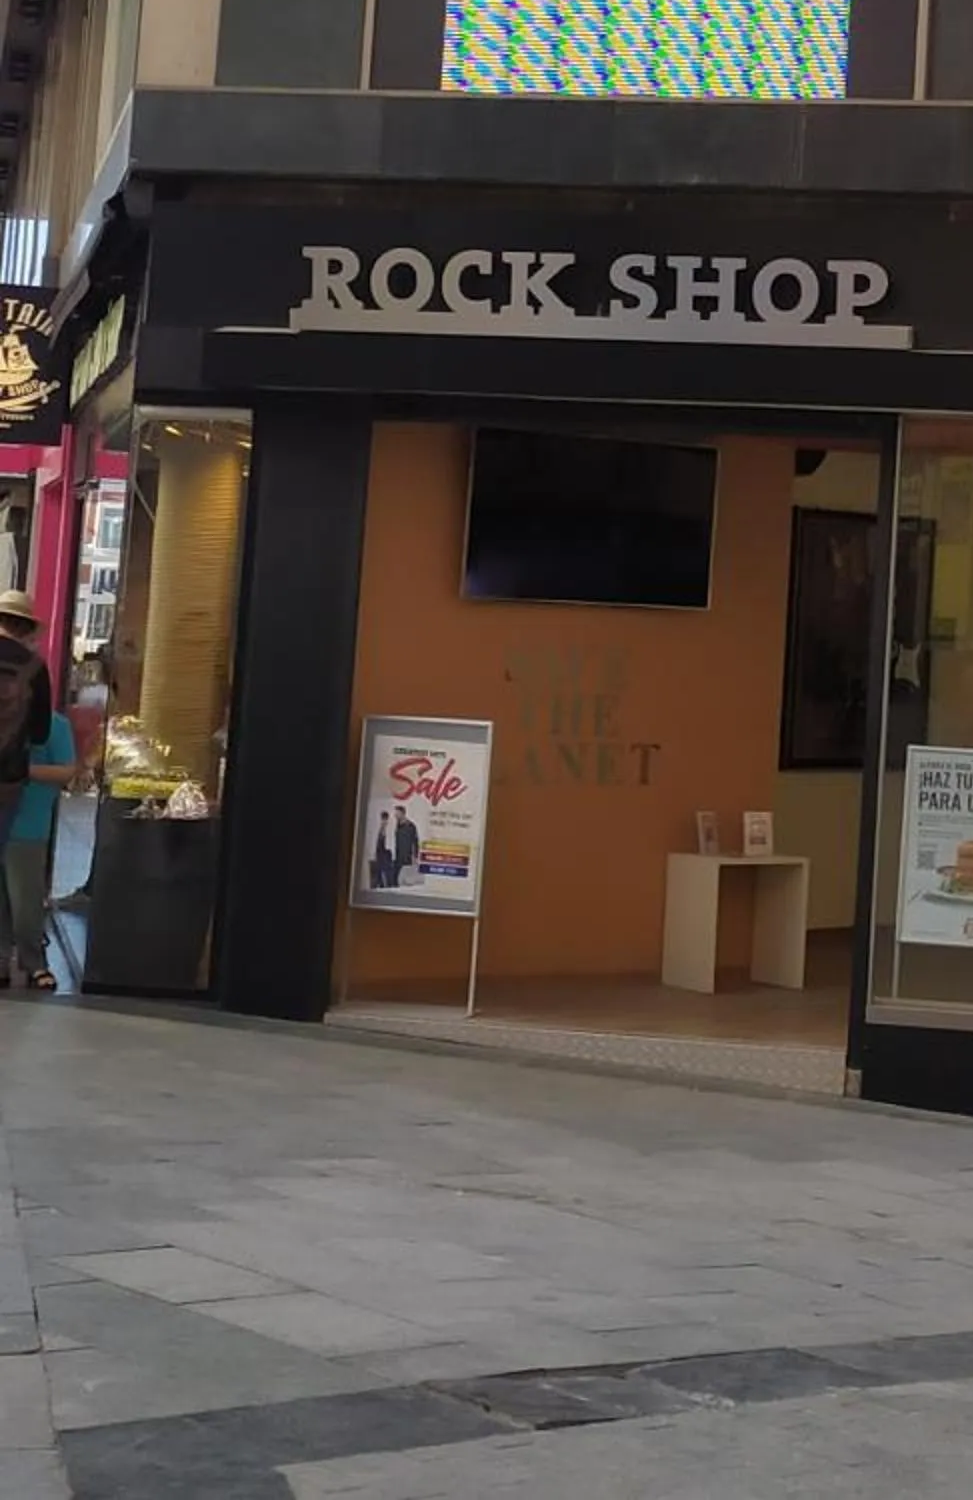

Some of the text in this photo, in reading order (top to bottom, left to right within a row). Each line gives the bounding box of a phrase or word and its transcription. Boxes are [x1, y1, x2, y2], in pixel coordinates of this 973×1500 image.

[302, 245, 889, 326] ROCK SHOP
[389, 757, 468, 806] Sale
[957, 772, 973, 790] TU
[918, 791, 961, 812] PARA
